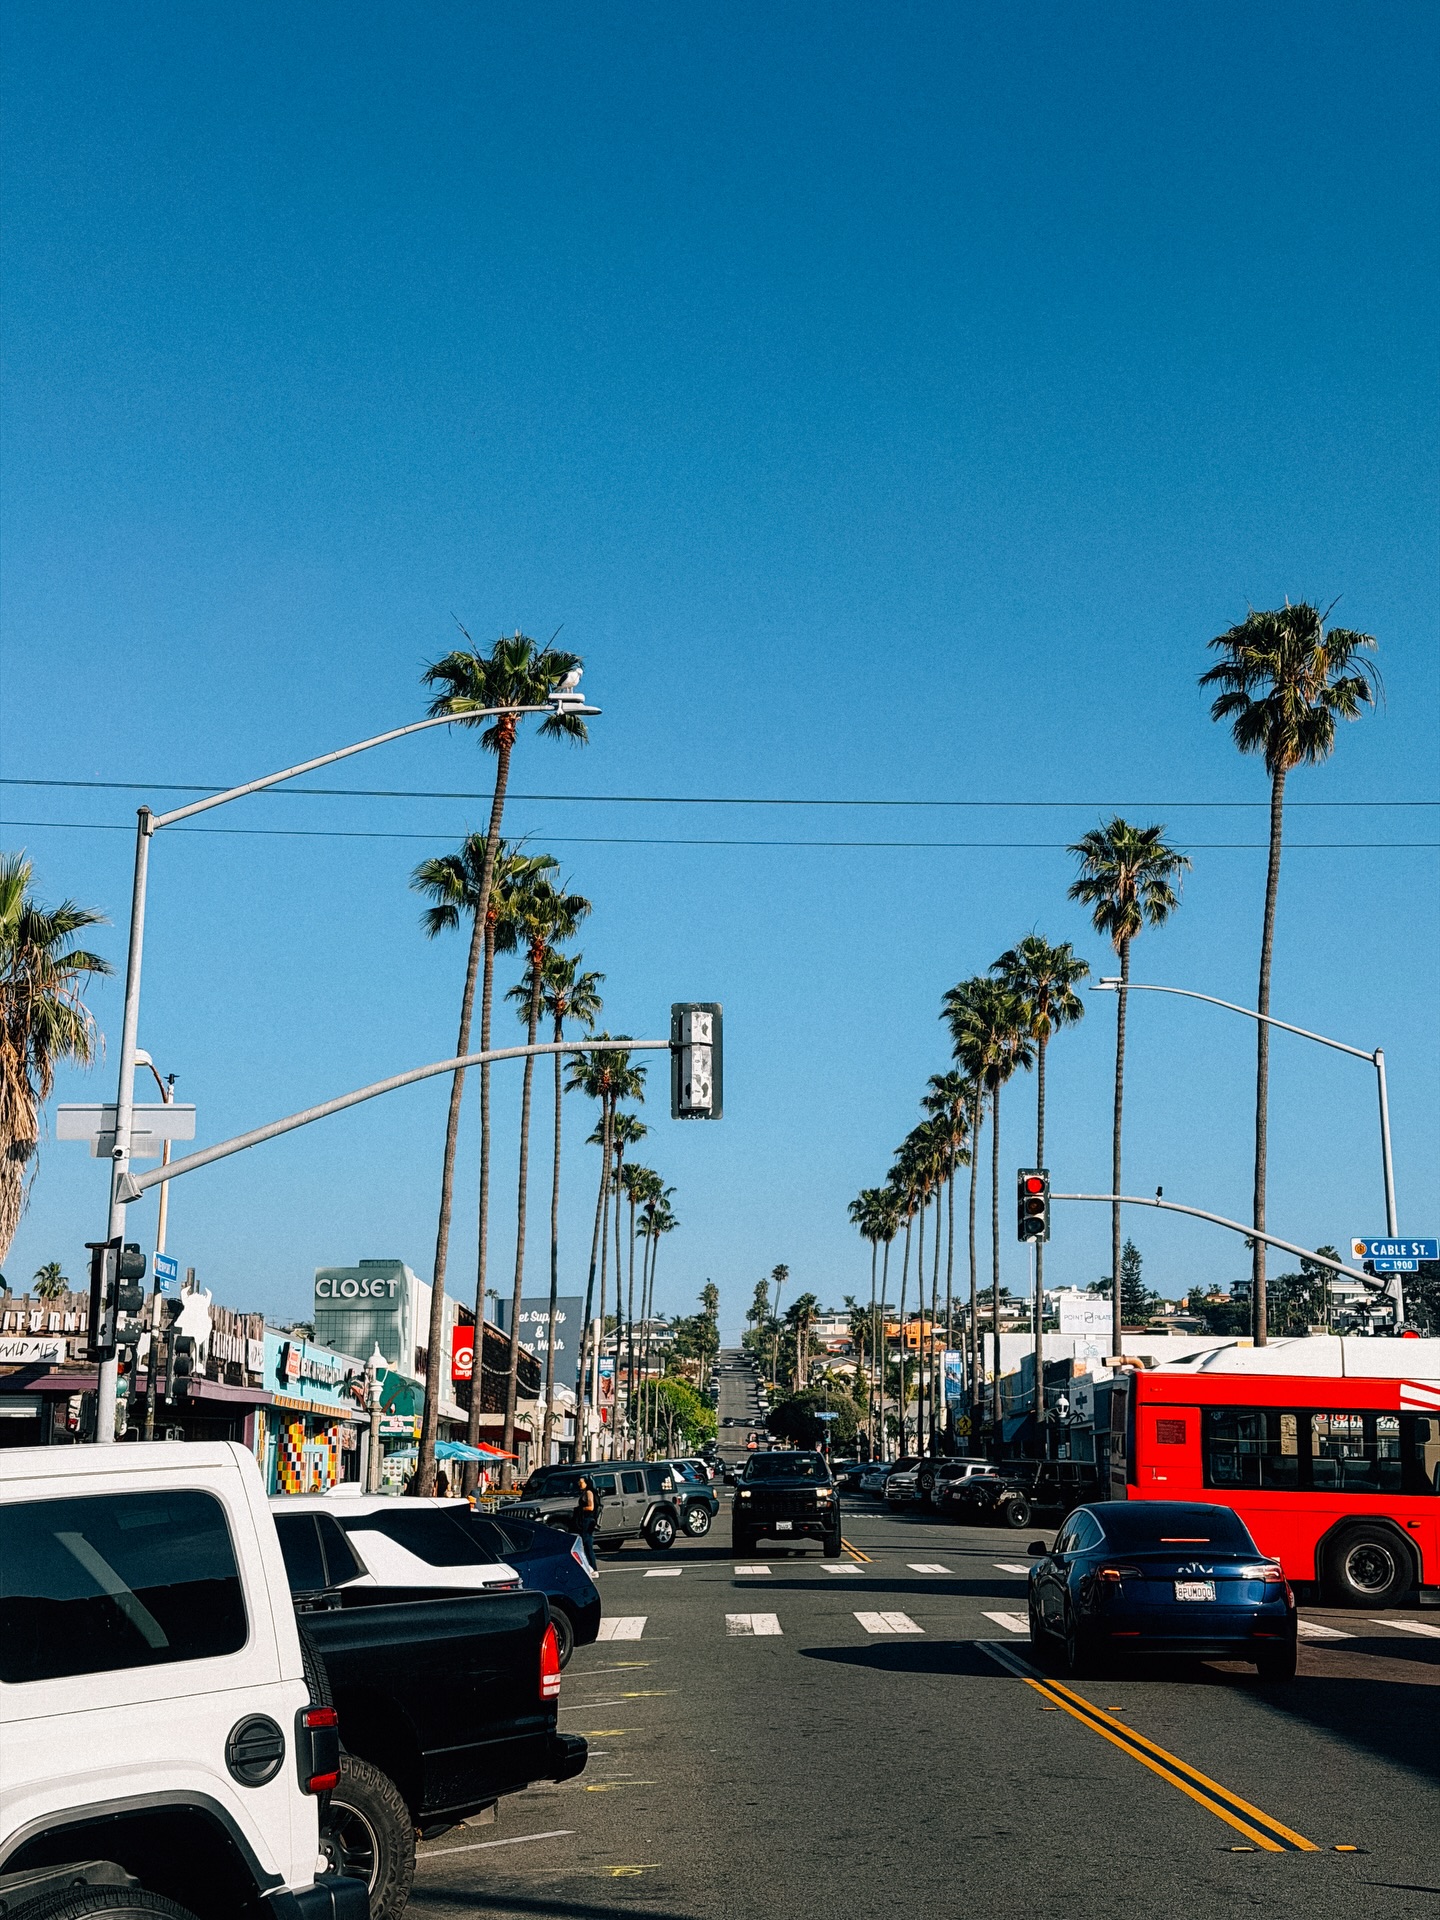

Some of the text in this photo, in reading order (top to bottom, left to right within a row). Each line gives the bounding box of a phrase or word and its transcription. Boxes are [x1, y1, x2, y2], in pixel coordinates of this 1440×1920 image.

[1371, 1242, 1429, 1256] CABLE ST.
[1393, 1260, 1412, 1270] 1900
[315, 1278, 398, 1298] CLOSET
[2, 1307, 87, 1333] IFORNI
[518, 1309, 566, 1324] et Suply
[535, 1325, 544, 1338] &
[537, 1338, 565, 1351] Wsh
[455, 1369, 472, 1377] targe
